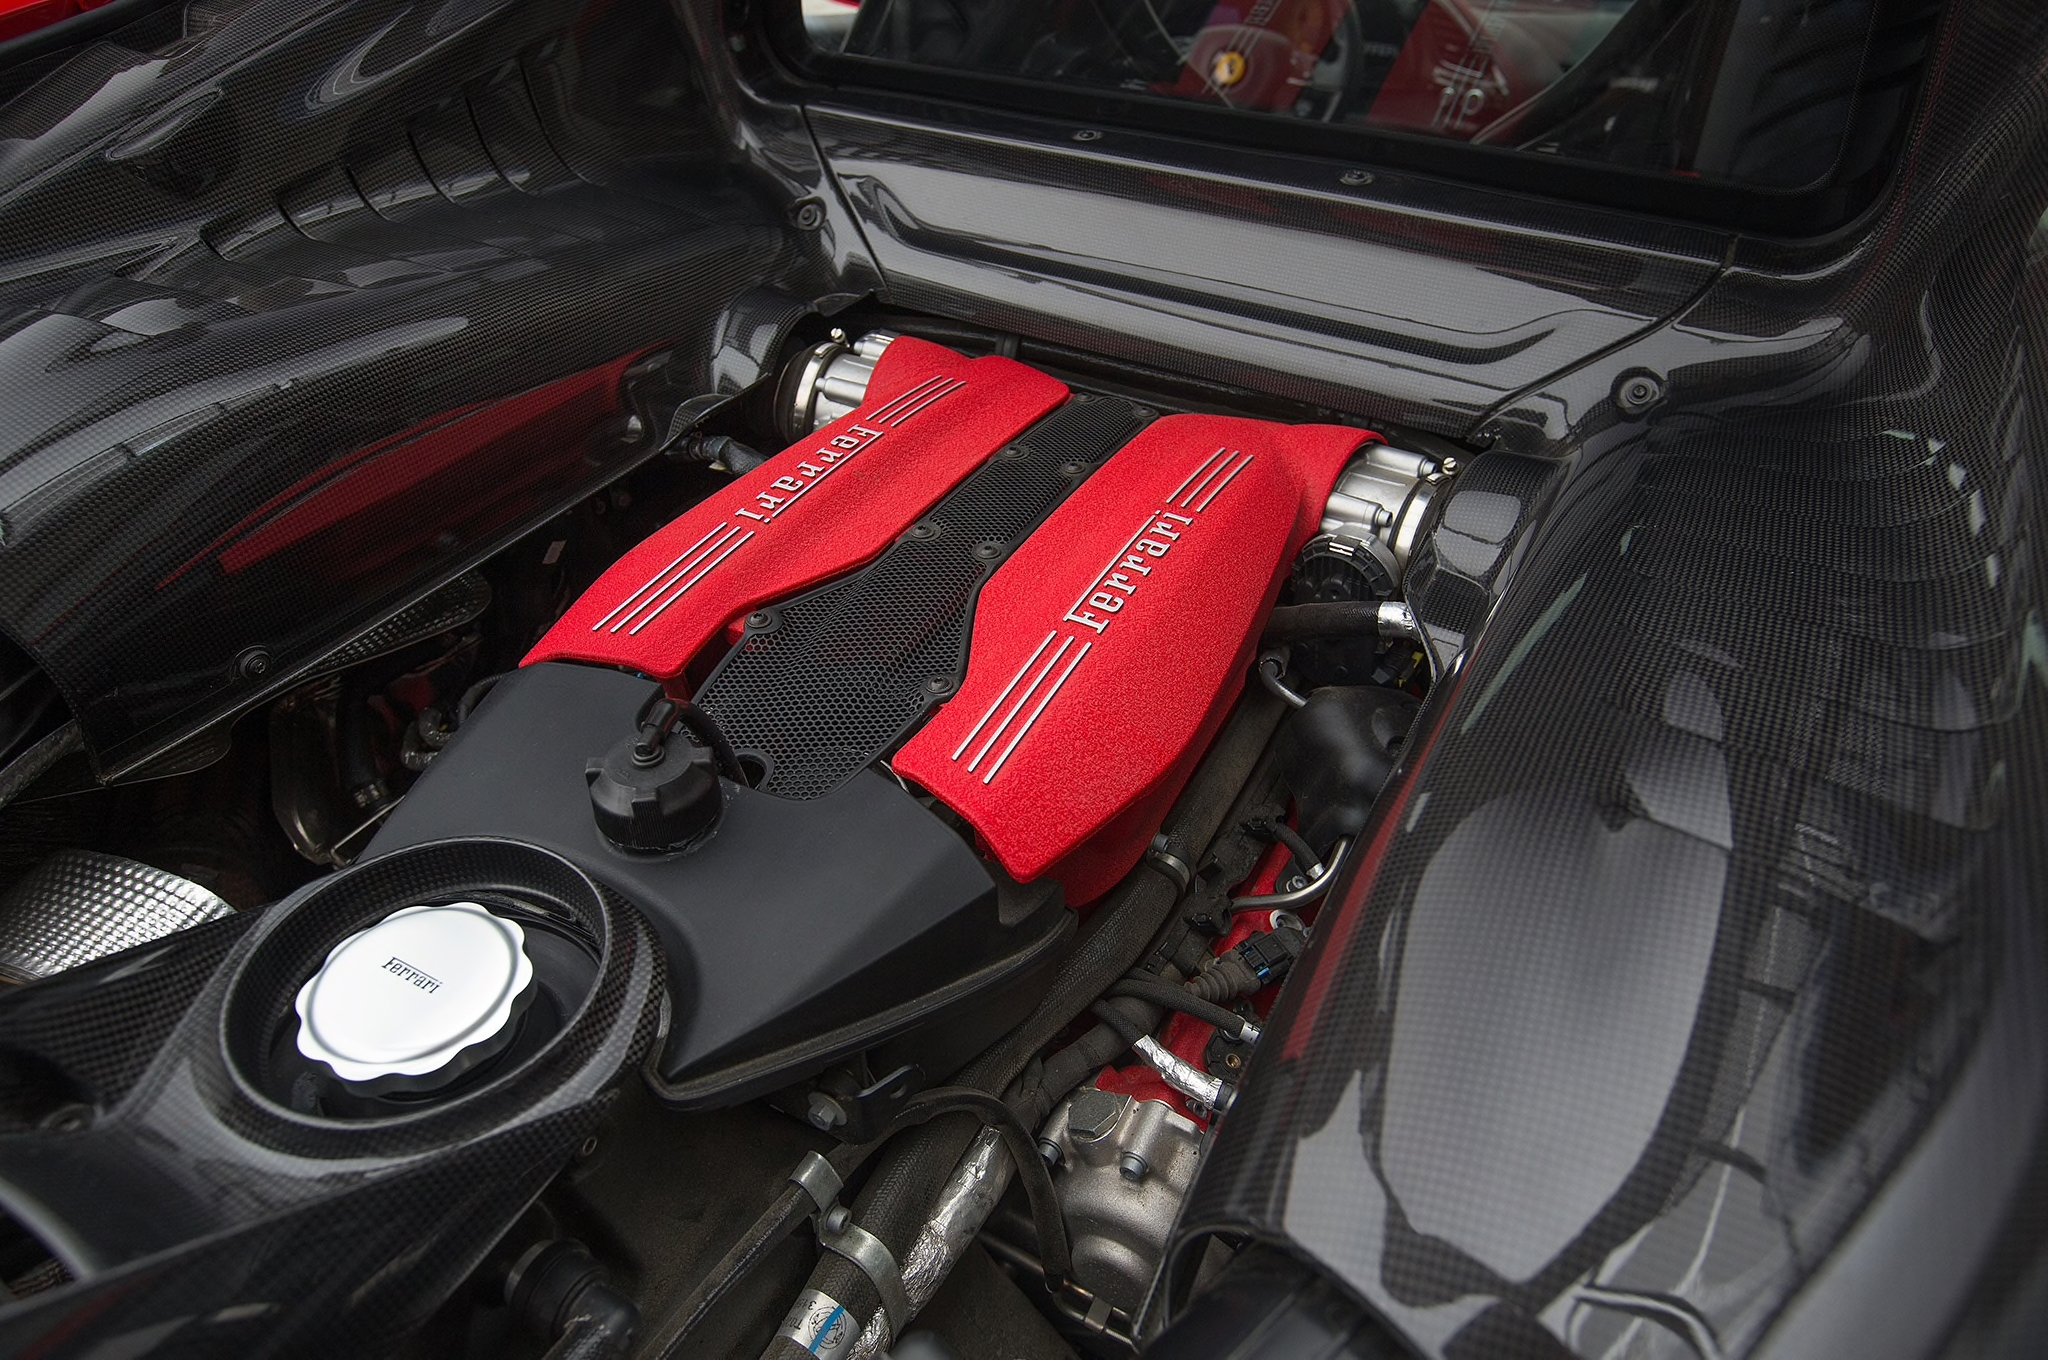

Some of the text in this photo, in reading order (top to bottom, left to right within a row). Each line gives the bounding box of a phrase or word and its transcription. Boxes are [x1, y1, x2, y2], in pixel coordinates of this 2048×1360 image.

[735, 424, 884, 524] Ferrari
[1063, 510, 1194, 634] Ferrari
[381, 956, 443, 994] Ferrari
